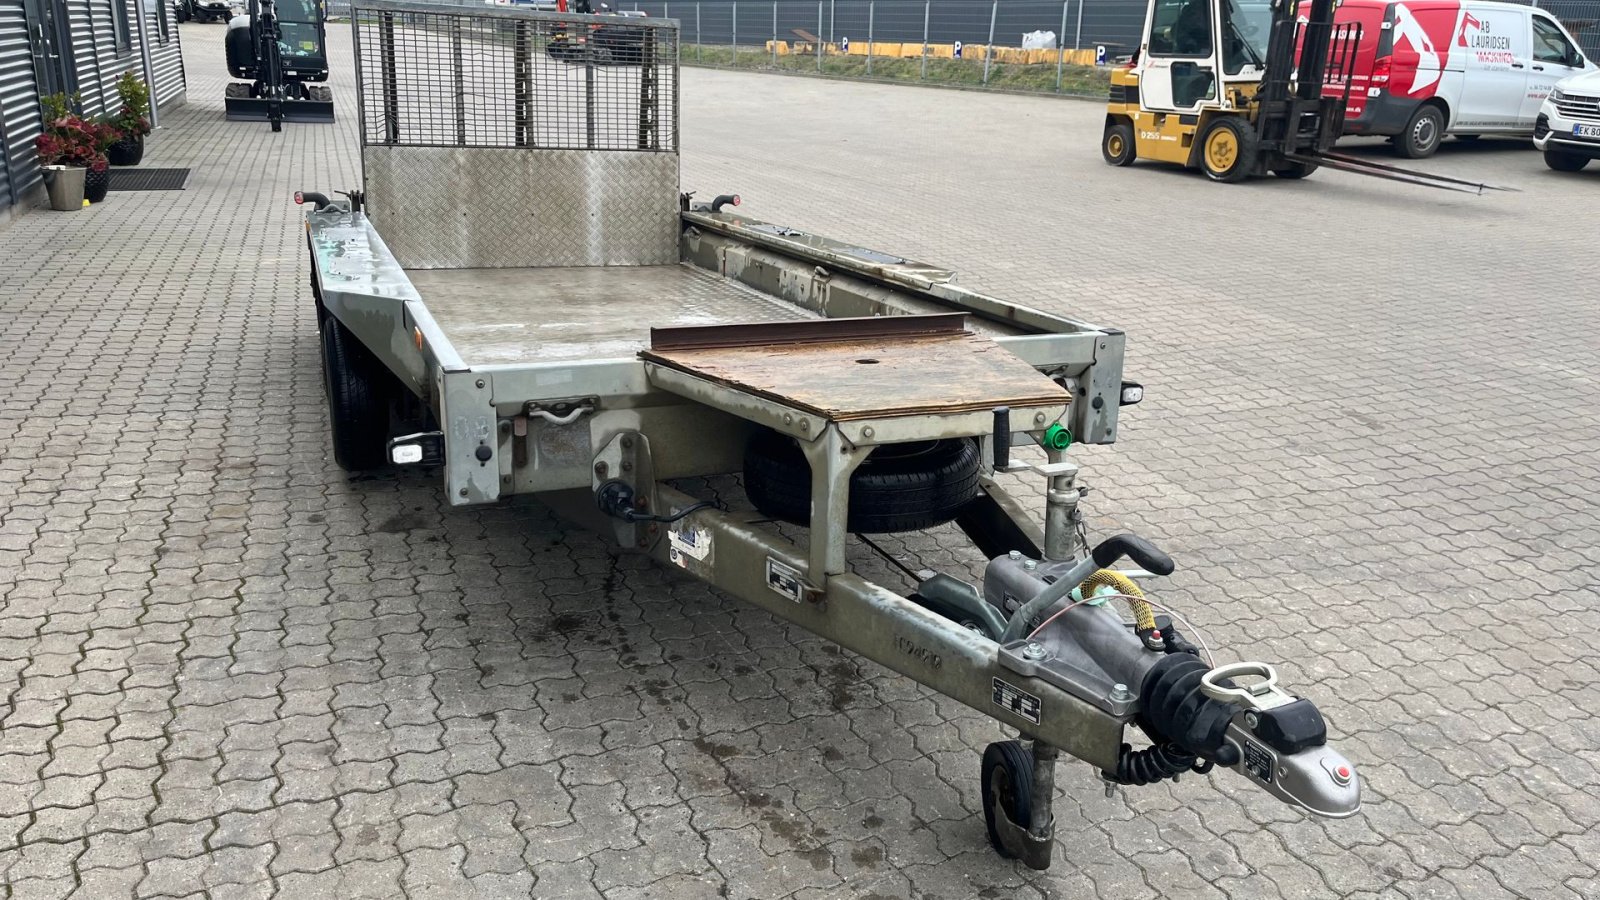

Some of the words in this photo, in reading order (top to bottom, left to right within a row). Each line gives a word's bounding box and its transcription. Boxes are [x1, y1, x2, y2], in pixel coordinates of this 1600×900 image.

[1481, 20, 1491, 34] AB
[842, 36, 849, 49] P
[954, 40, 962, 55] P
[1471, 35, 1510, 49] LAURIDSEN
[1096, 45, 1106, 61] P
[1578, 126, 1590, 135] EK
